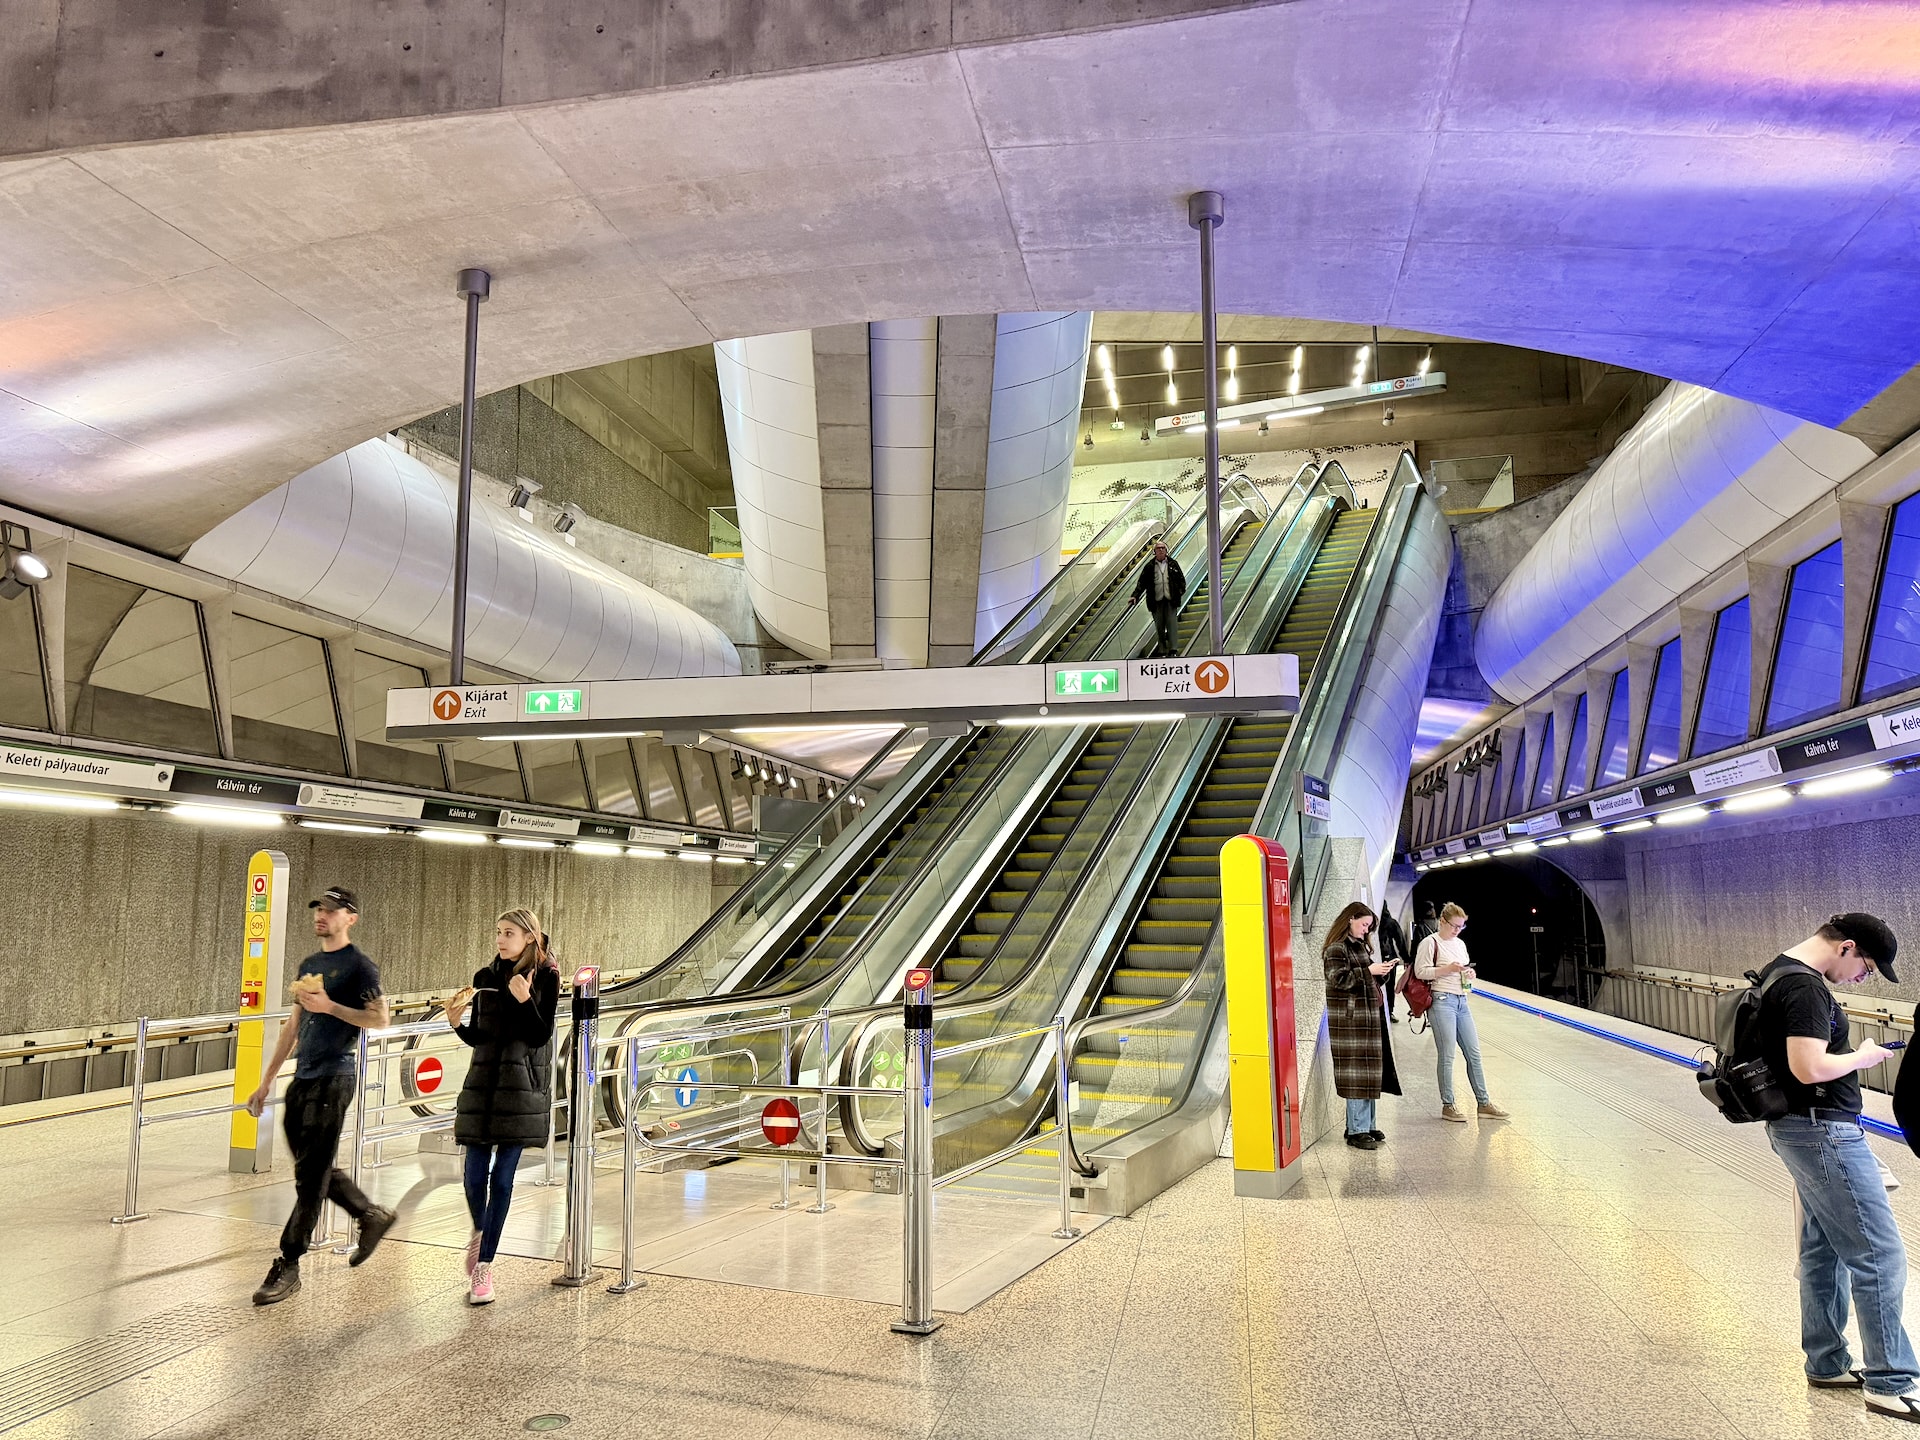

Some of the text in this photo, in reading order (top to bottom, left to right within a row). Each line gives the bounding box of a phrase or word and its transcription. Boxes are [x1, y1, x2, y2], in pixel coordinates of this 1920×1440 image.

[1140, 663, 1191, 679] Kijárat
[1164, 681, 1191, 694] Exit
[465, 690, 508, 705] Kijárat
[464, 707, 487, 719] Exit
[1804, 738, 1839, 758] Kálvin tér
[6, 752, 110, 776] Keleti pályaudvar
[217, 779, 263, 794] Kálvin tér
[449, 807, 477, 820] Kálvin tér
[251, 921, 264, 930] SOS
